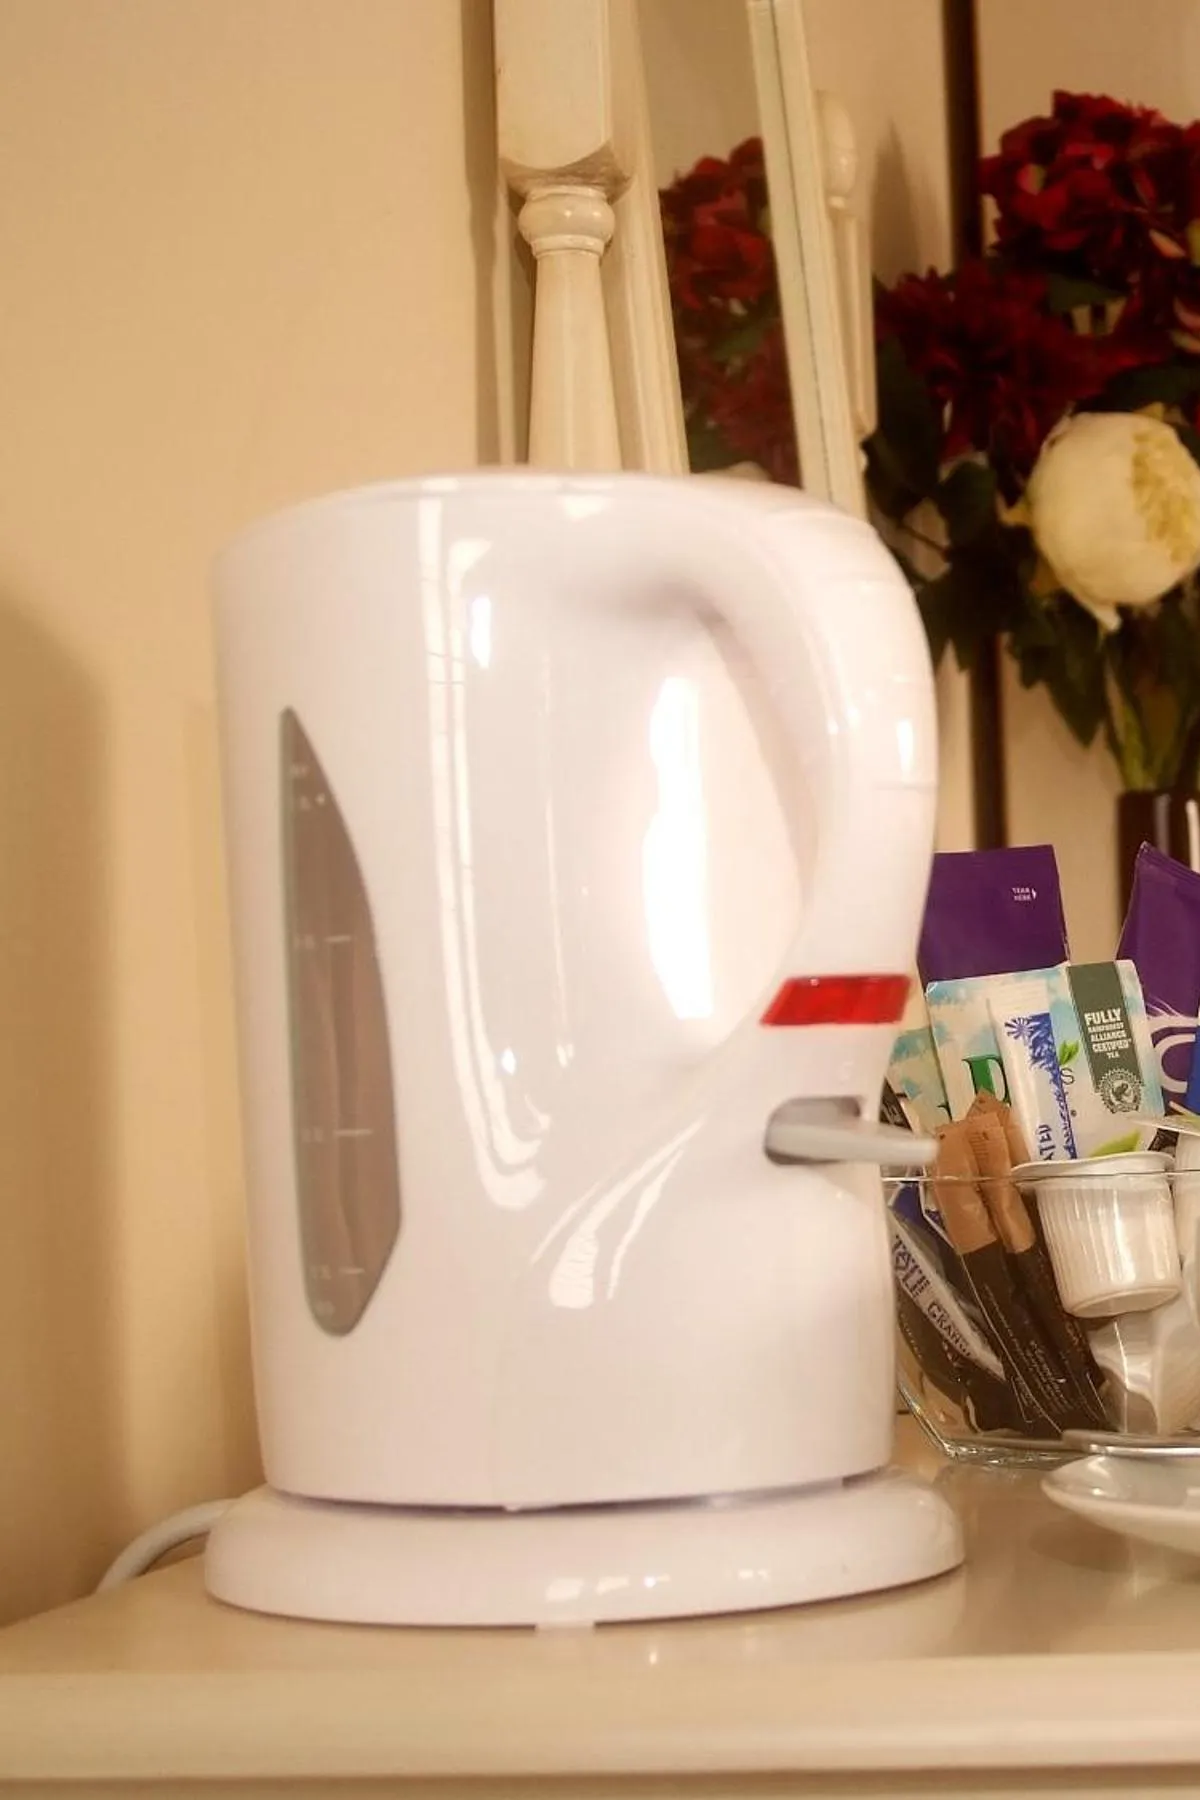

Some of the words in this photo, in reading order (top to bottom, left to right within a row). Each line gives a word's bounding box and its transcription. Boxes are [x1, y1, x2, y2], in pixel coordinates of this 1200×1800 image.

[1084, 1008, 1121, 1027] FULLY
[1090, 1030, 1127, 1043] ALLIANCE
[1106, 1051, 1120, 1060] TEA
